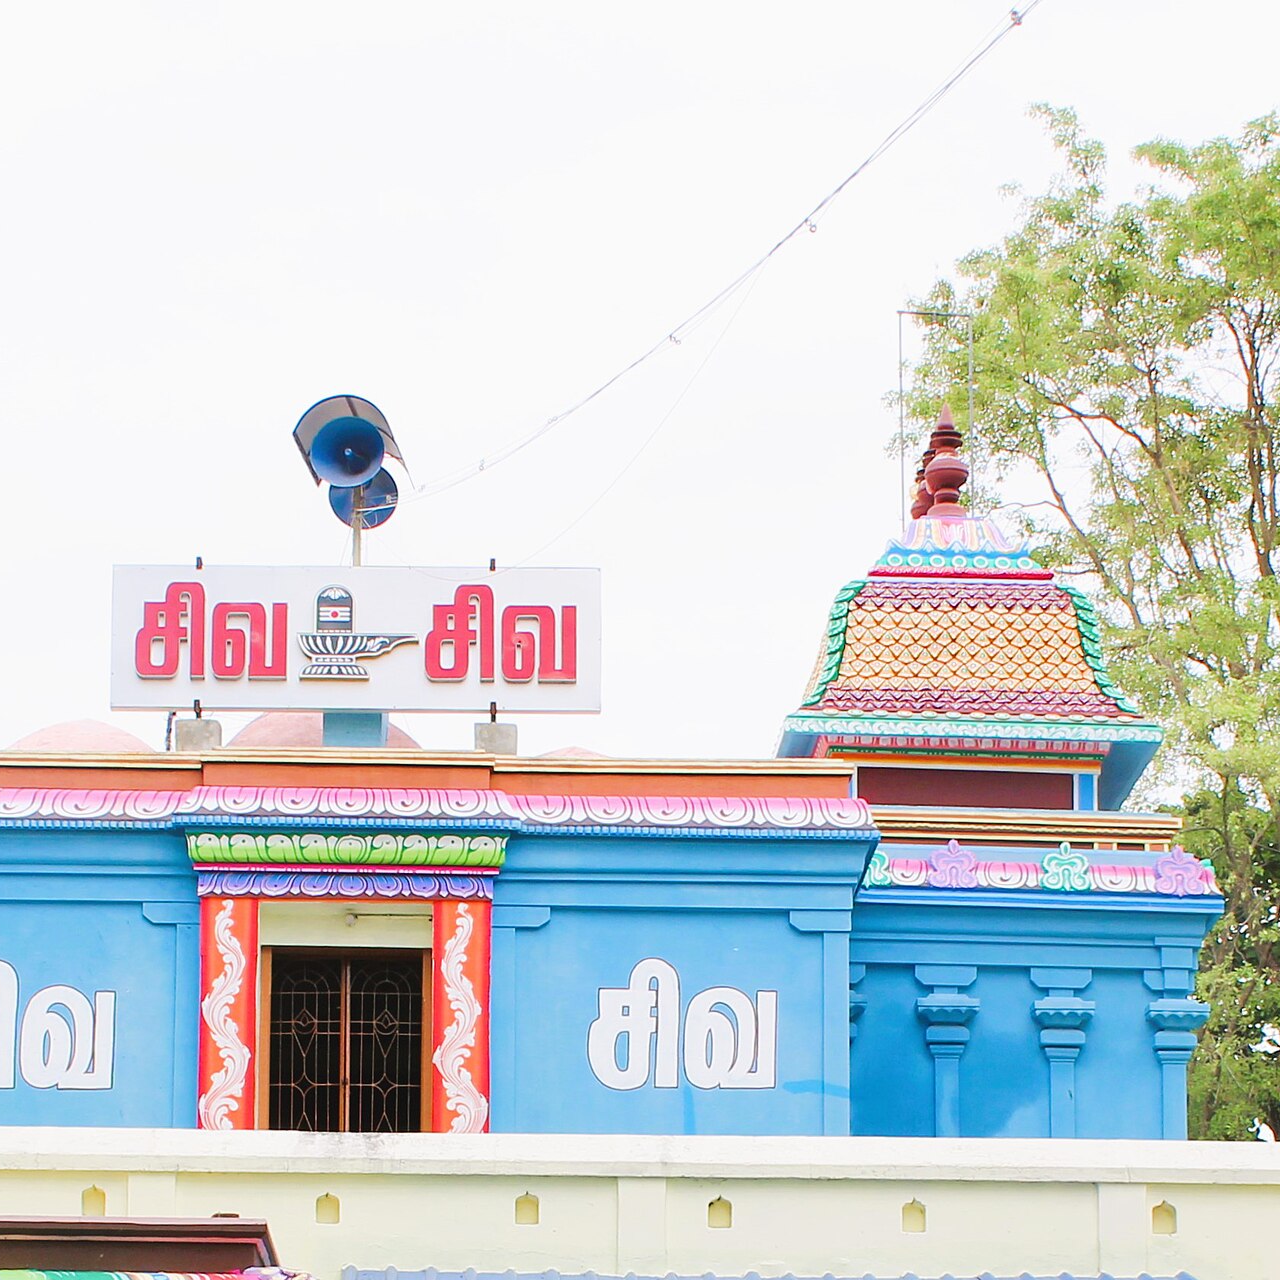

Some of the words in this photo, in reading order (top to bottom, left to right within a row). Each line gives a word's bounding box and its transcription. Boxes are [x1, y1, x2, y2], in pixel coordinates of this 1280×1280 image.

[135, 581, 288, 679] சிவ
[424, 584, 577, 682] சிவ
[587, 957, 780, 1091] சிவ
